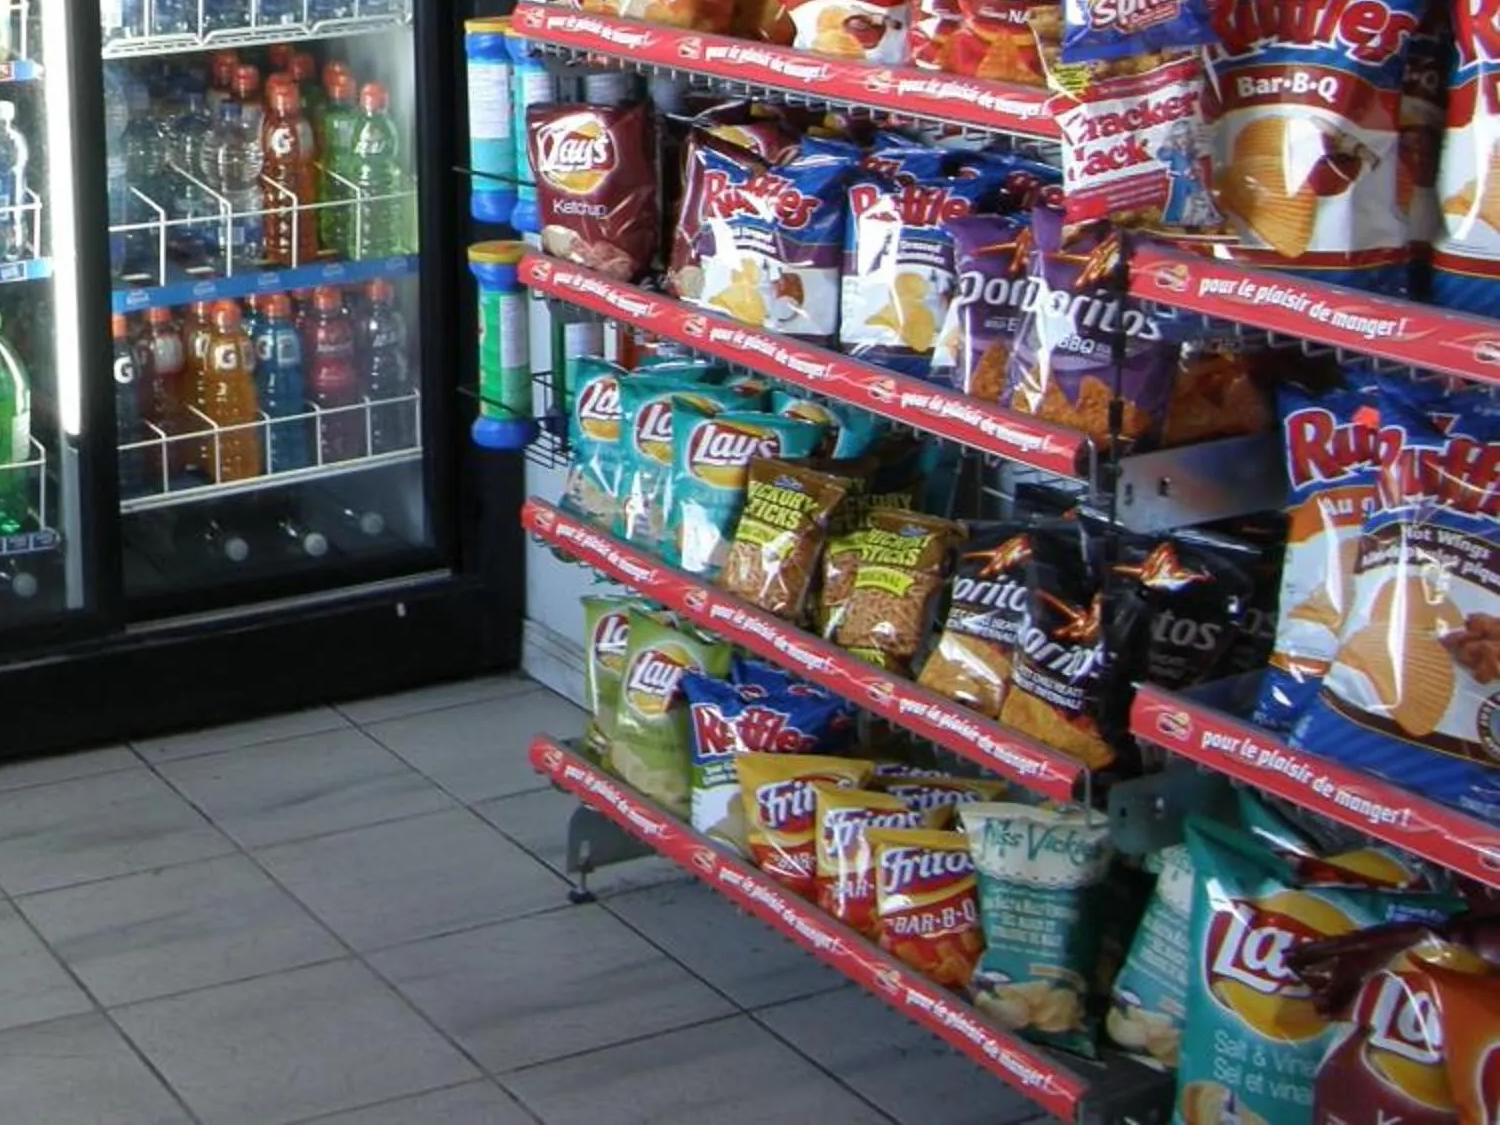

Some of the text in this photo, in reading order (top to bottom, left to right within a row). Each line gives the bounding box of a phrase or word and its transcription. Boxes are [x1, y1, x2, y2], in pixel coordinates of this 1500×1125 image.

[540, 124, 609, 170] Lay's
[551, 198, 608, 218] Ketchup
[1199, 277, 1236, 296] pour
[1238, 278, 1255, 297] le
[1255, 282, 1312, 312] plaisir
[1310, 301, 1330, 322] de
[1332, 311, 1396, 340] manger
[1202, 731, 1239, 752] pour
[1240, 738, 1257, 758] le
[1257, 749, 1315, 784] plaisir
[1312, 776, 1335, 798] de
[1334, 788, 1399, 824] manger
